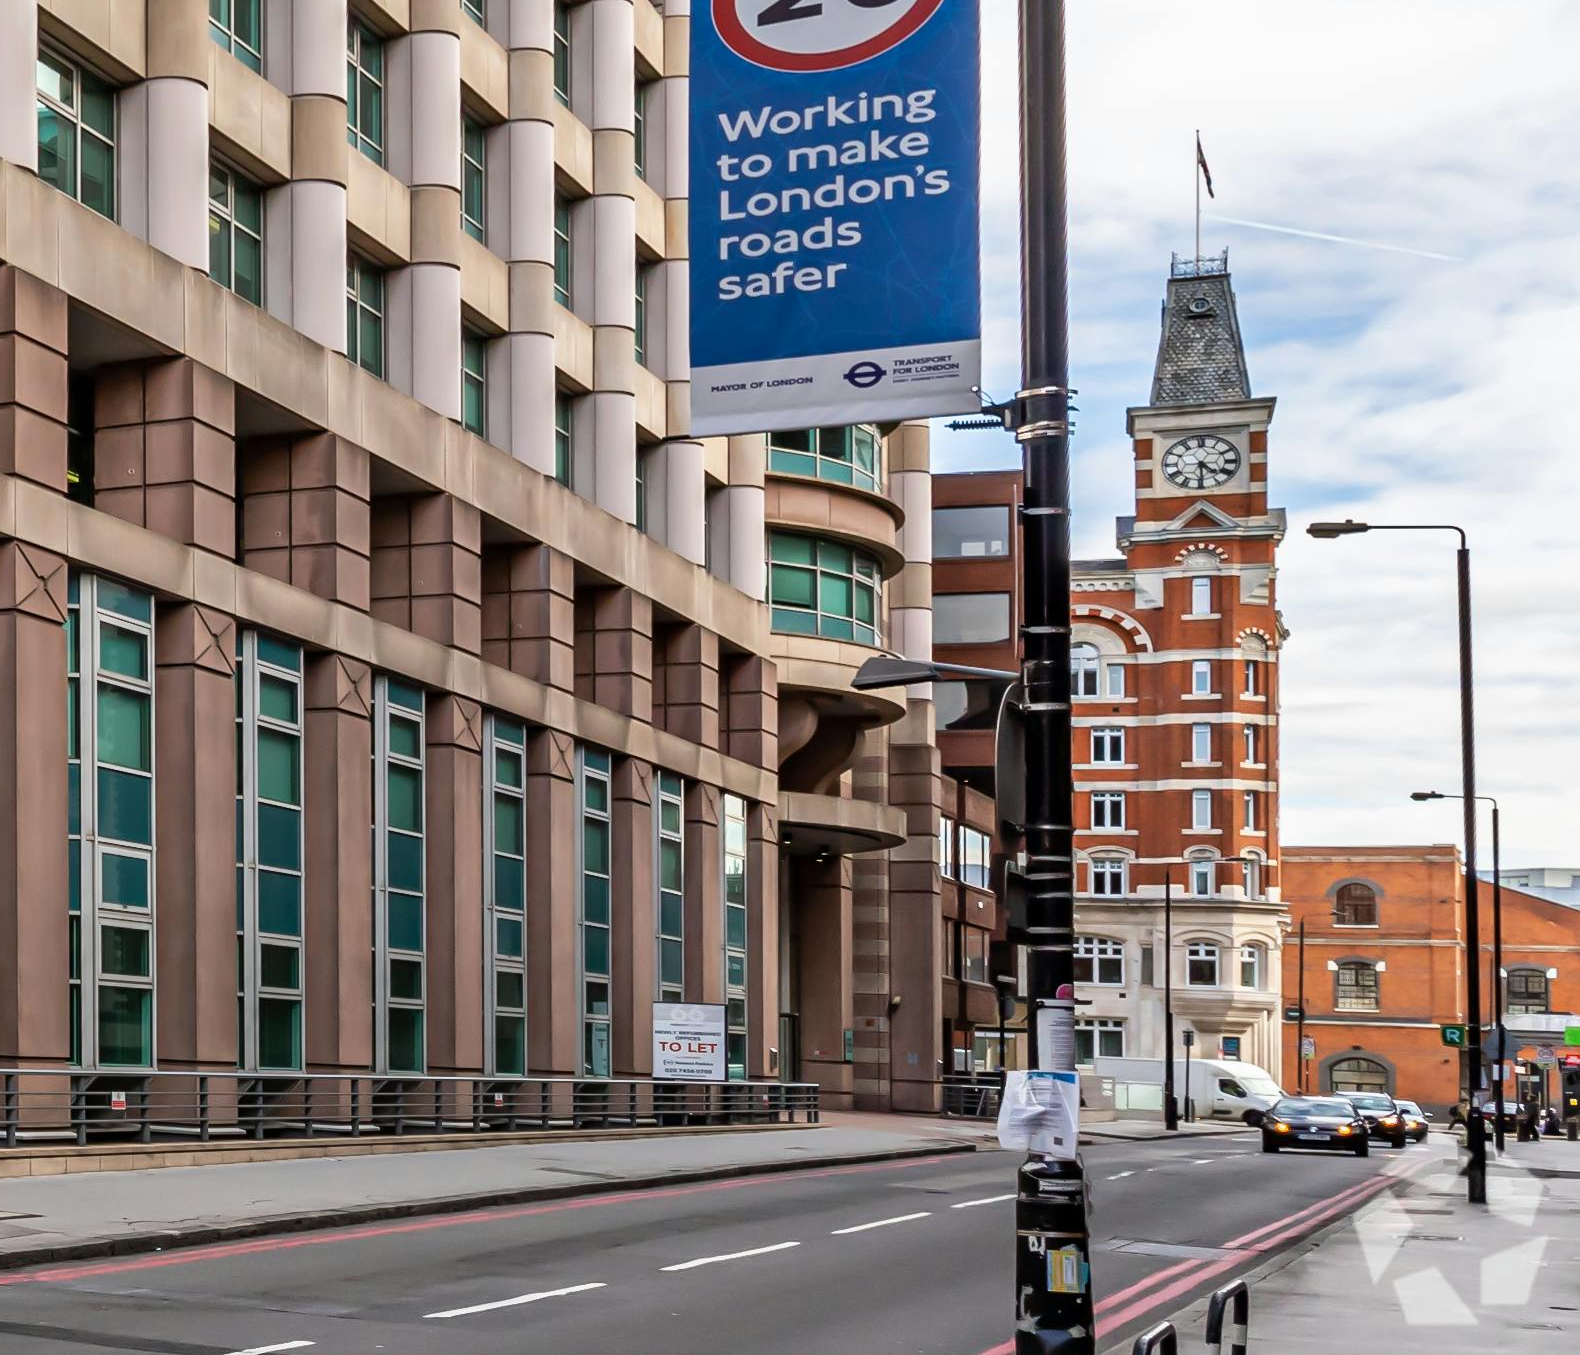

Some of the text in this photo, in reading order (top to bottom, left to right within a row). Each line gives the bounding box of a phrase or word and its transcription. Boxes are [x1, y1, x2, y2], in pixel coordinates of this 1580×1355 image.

[718, 89, 936, 142] Working
[716, 130, 929, 181] to make
[720, 164, 951, 221] London's
[720, 217, 862, 260] roads
[719, 261, 847, 300] safer
[893, 354, 952, 367] TRANSPORT
[893, 362, 959, 376] FOR LONDON
[711, 377, 813, 393] MAYOR OF LONDON
[658, 1041, 718, 1054] TO LET
[1445, 1029, 1460, 1042] R
